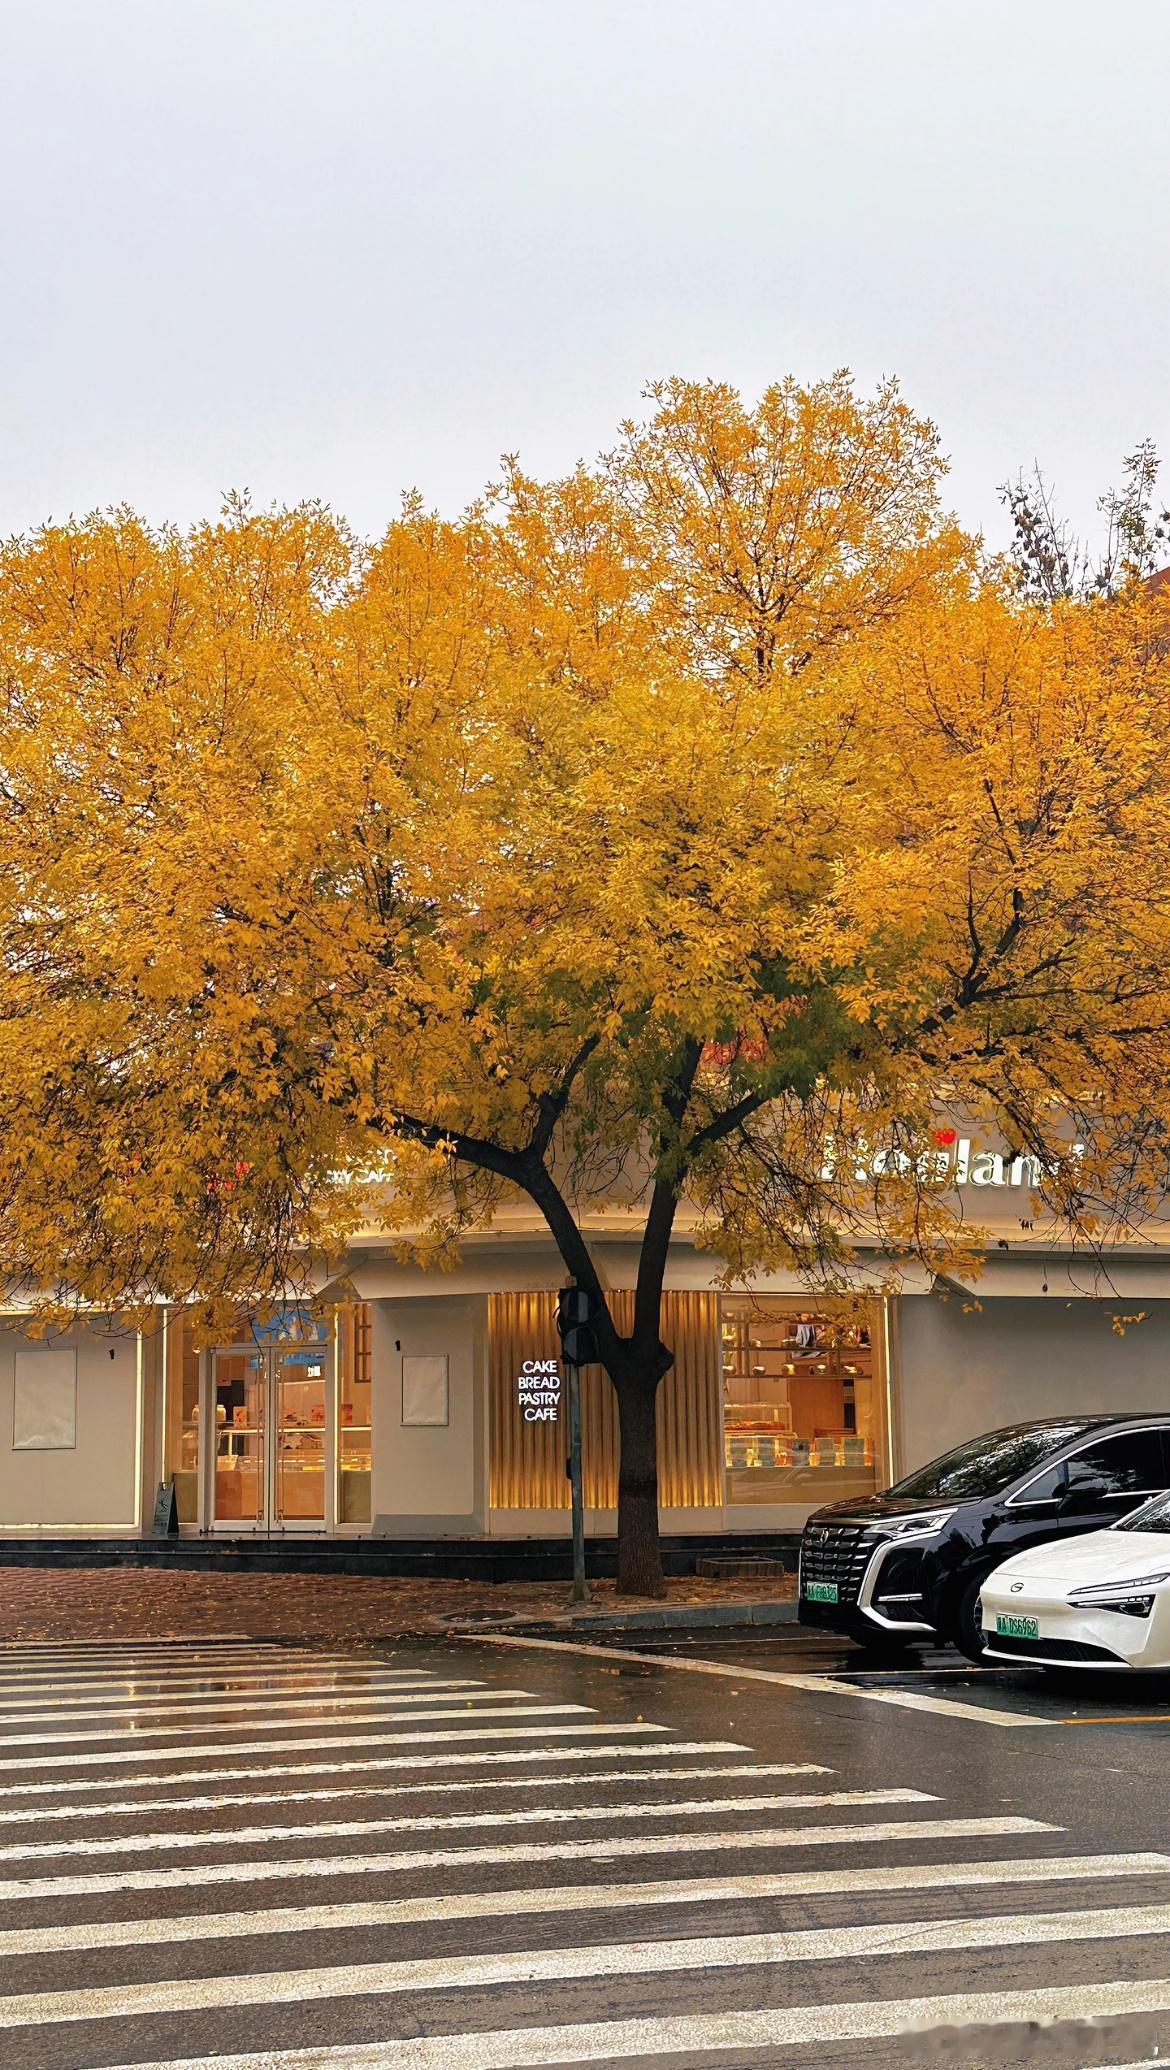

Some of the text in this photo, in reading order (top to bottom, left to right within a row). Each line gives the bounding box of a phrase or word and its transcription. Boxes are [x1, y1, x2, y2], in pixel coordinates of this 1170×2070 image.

[522, 1360, 557, 1372] CAKE
[518, 1376, 560, 1389] BREAD
[518, 1392, 560, 1405] PASTRY
[524, 1408, 557, 1421] CAFE
